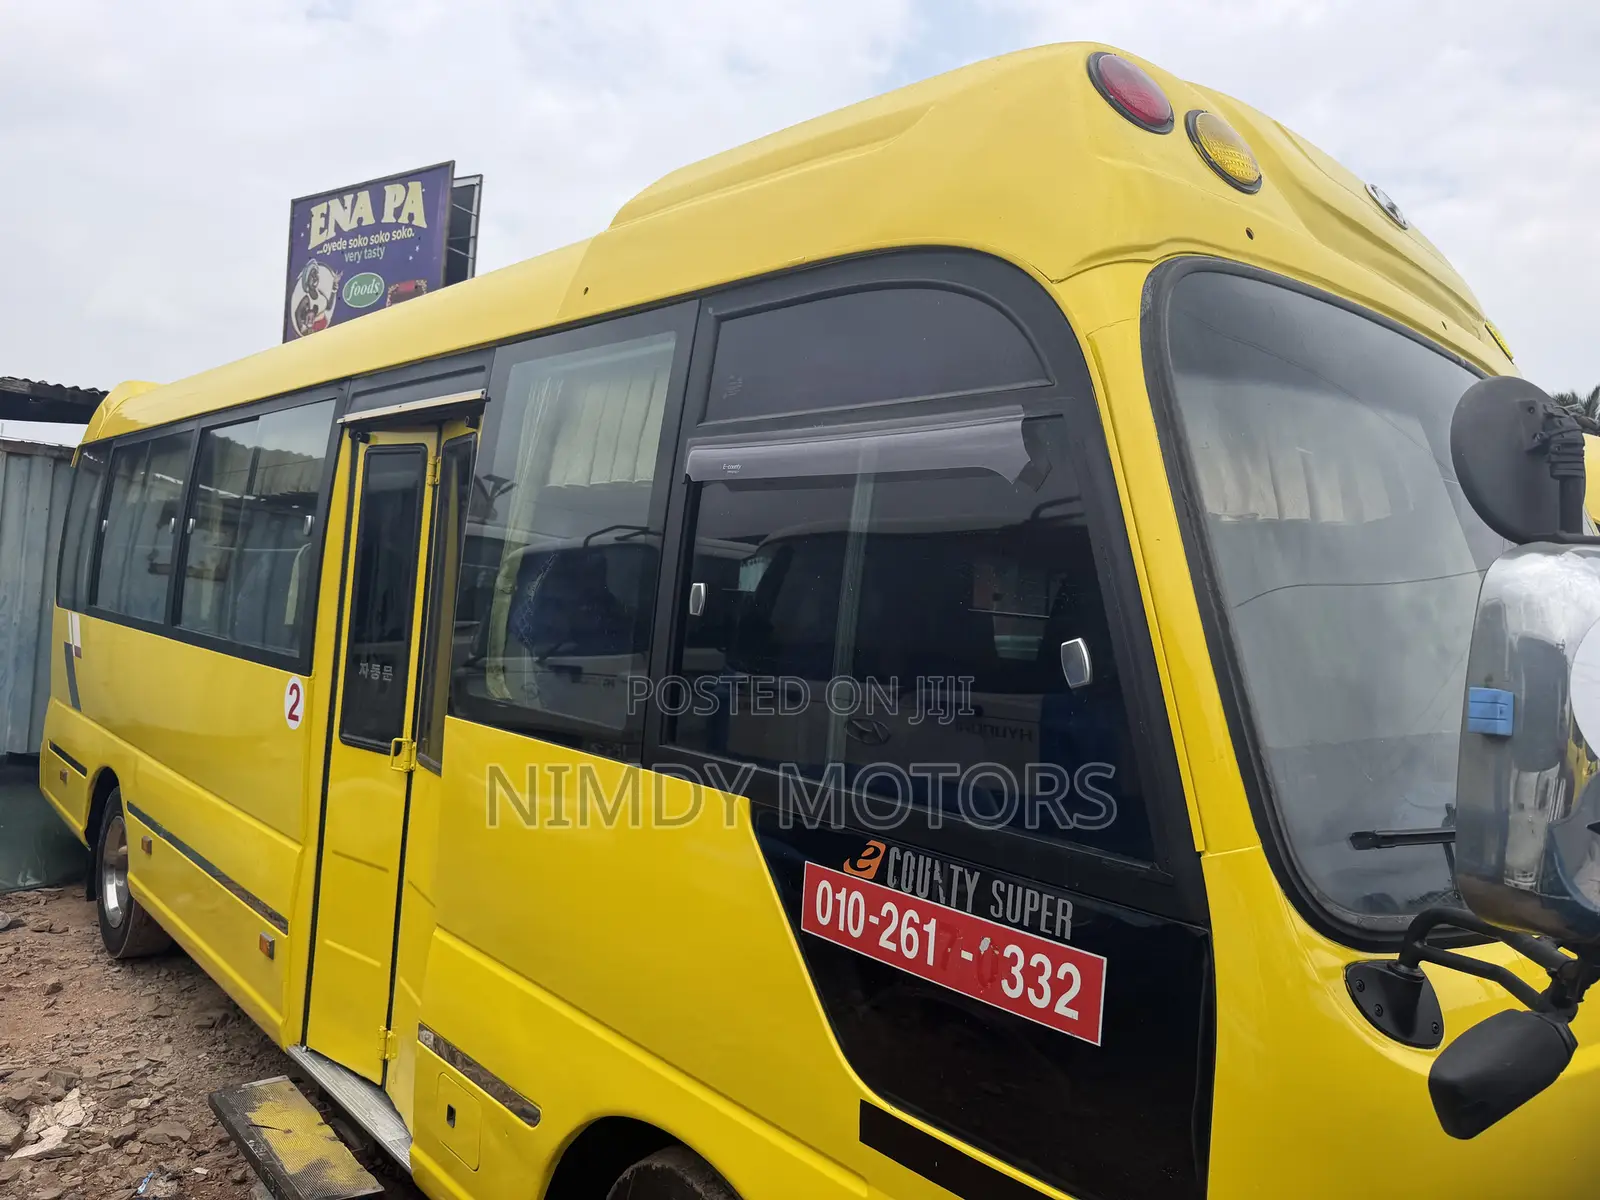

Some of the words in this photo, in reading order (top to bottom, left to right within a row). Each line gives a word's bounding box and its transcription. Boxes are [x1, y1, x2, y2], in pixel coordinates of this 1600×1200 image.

[308, 190, 375, 250] ENA
[381, 181, 427, 228] PA
[349, 234, 368, 248] soko
[369, 231, 390, 246] soko
[392, 227, 415, 241] soko.
[344, 250, 363, 263] very
[364, 246, 385, 260] tasty
[347, 279, 380, 301] foods
[358, 662, 393, 681] 자동문
[287, 682, 301, 722] 2
[886, 846, 980, 914] COUNTY
[990, 879, 1073, 940] SUPER
